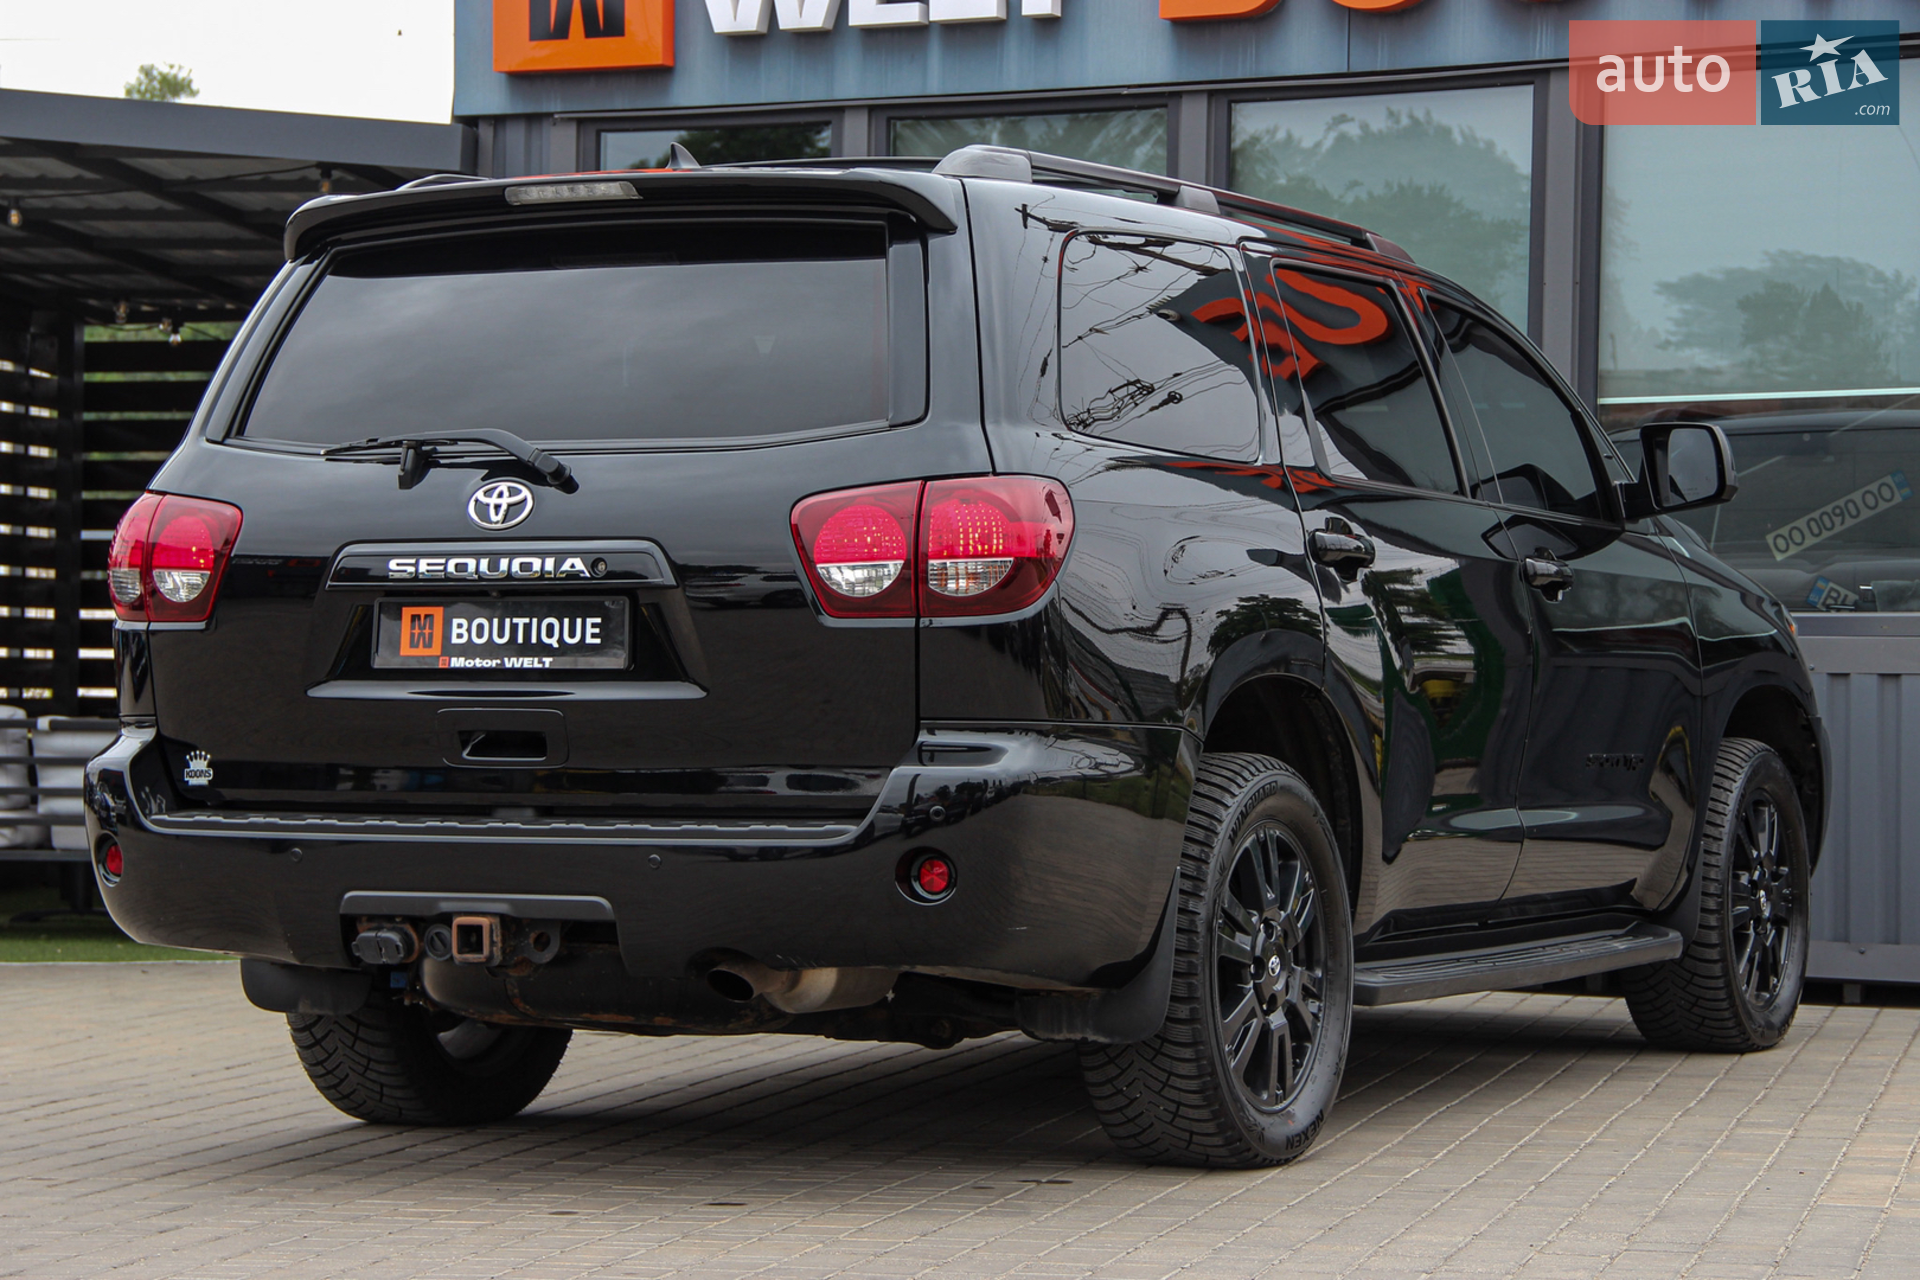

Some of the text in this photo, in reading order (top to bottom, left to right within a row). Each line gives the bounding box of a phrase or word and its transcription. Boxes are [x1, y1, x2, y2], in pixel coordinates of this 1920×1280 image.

[388, 557, 591, 580] SEQUOIA
[450, 617, 602, 648] BOUTIQUE
[450, 657, 501, 668] Motor
[504, 657, 553, 668] WELT
[1285, 1108, 1324, 1150] NEXEN
